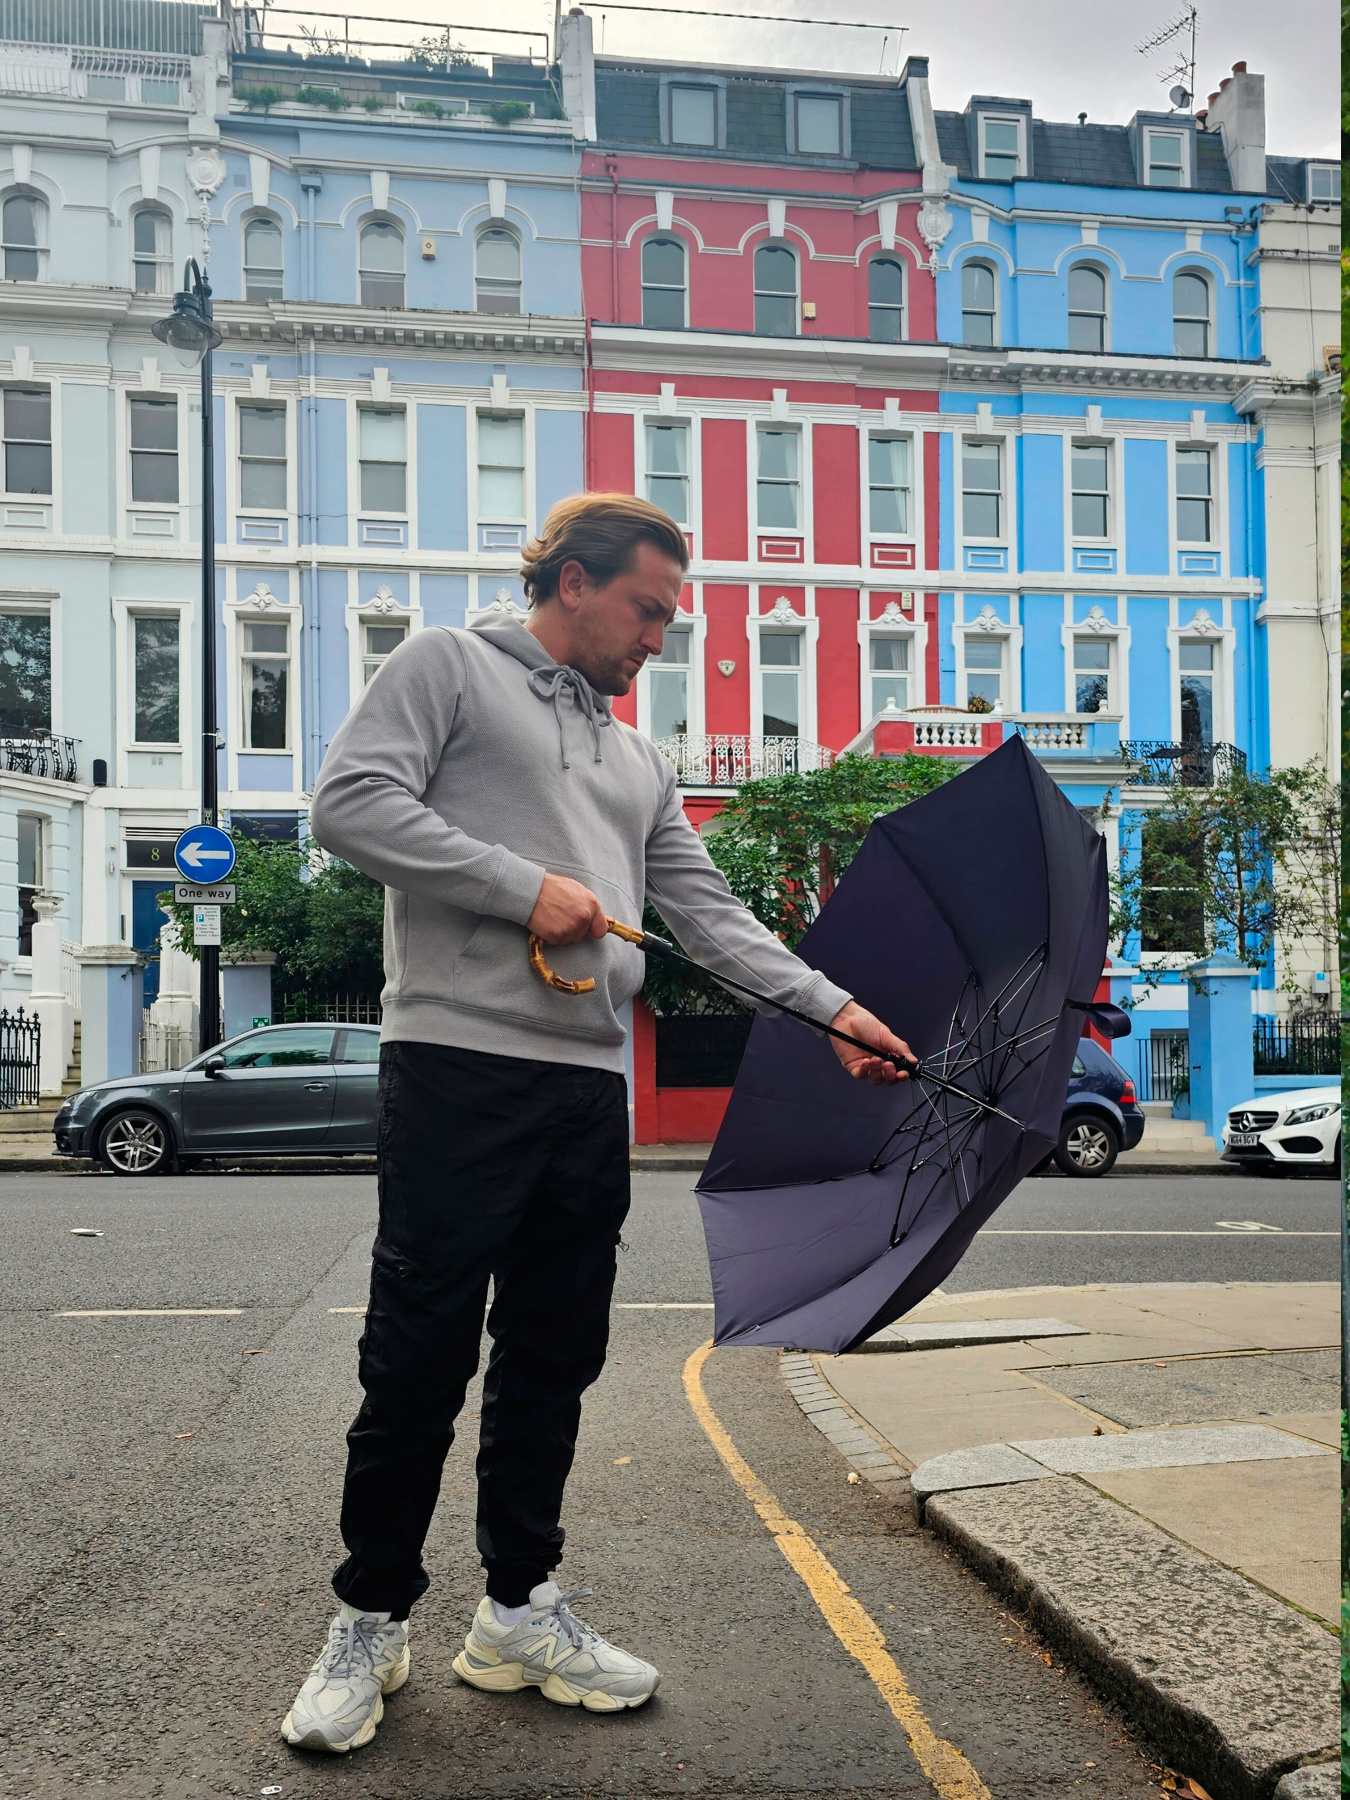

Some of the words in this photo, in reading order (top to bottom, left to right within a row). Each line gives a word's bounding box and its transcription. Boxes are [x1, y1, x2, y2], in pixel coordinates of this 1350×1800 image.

[151, 847, 160, 861] 8
[179, 888, 203, 898] One
[207, 889, 232, 899] way
[522, 1633, 579, 1670] N
